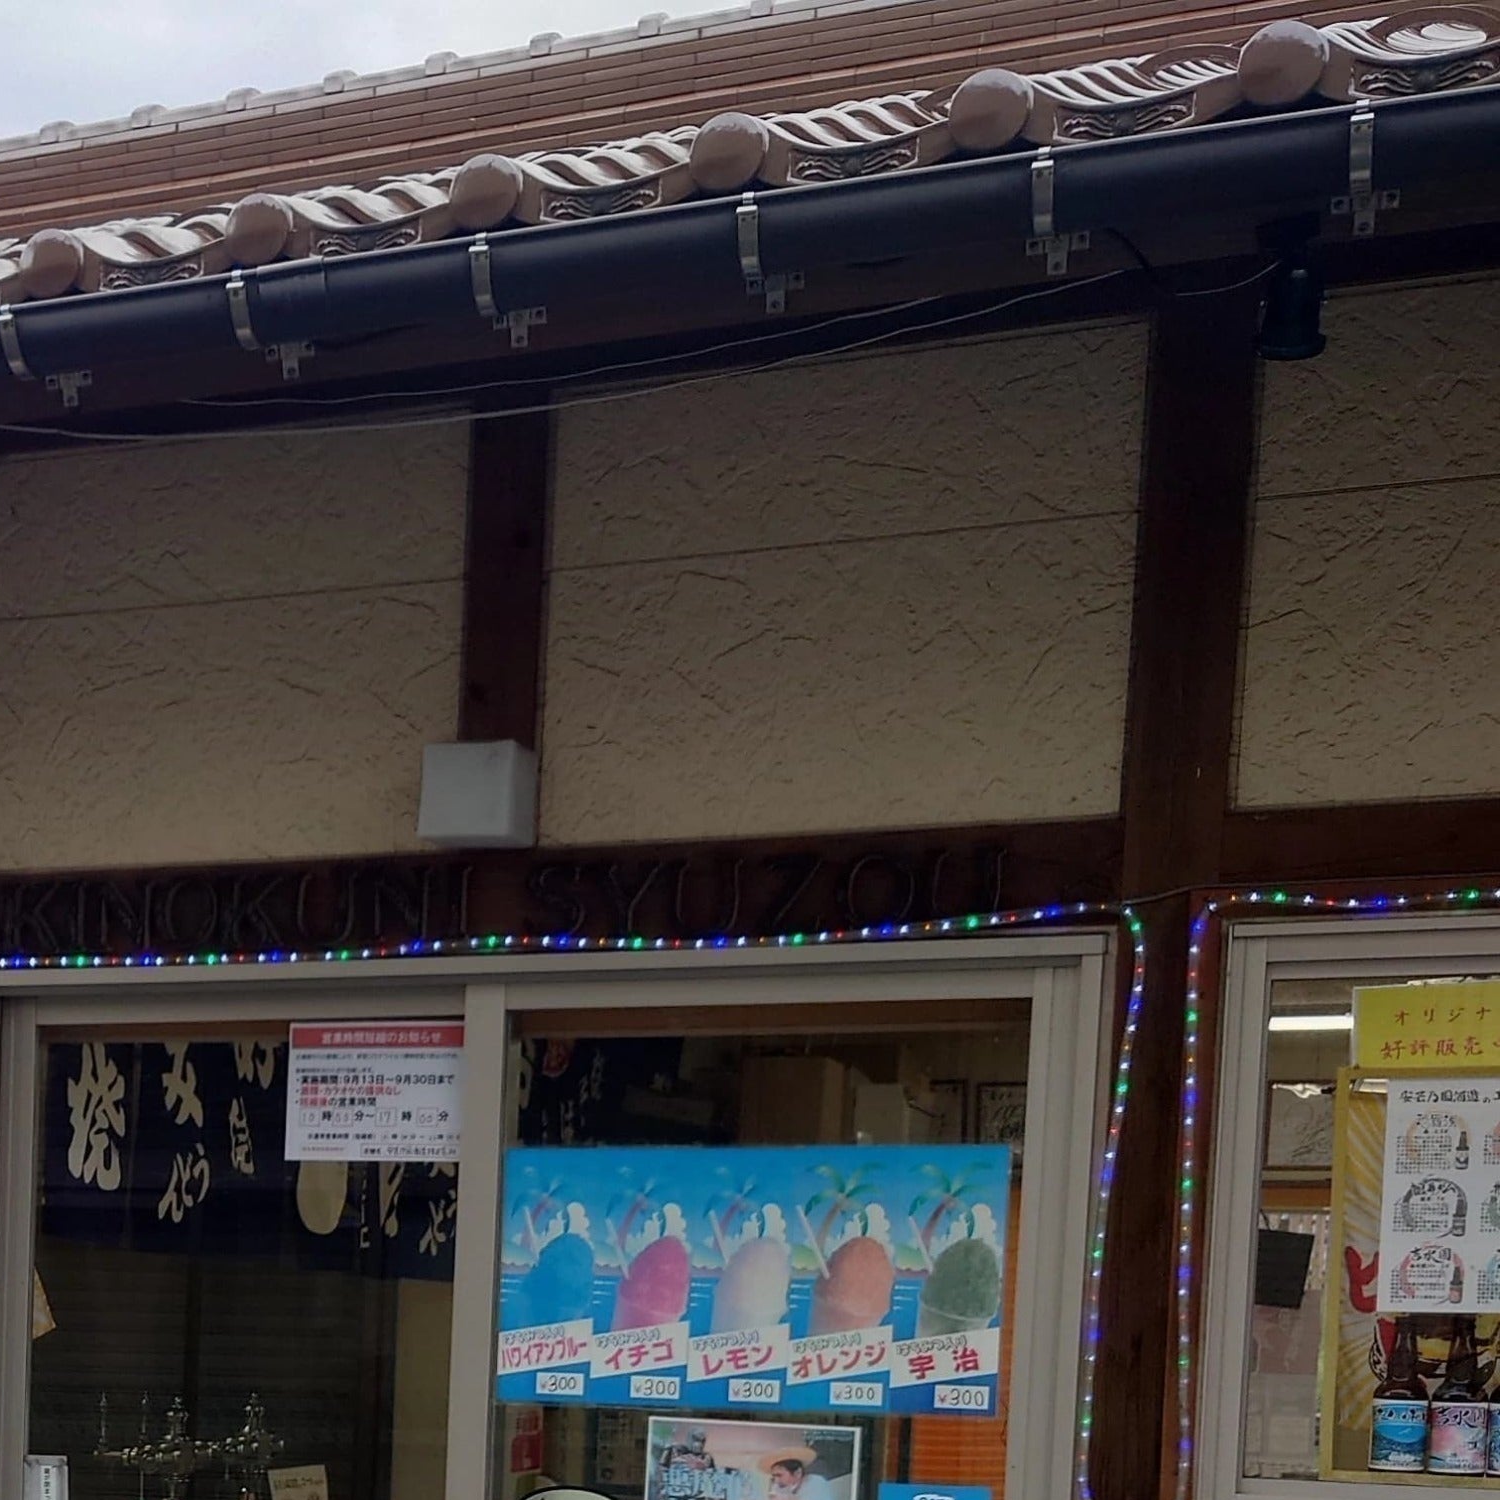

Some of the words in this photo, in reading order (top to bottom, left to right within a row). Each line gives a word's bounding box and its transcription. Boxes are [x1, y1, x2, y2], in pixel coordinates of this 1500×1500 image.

[703, 1346, 773, 1376] レモン
[792, 1341, 885, 1378] オレンジ
[908, 1347, 979, 1380] 宇治
